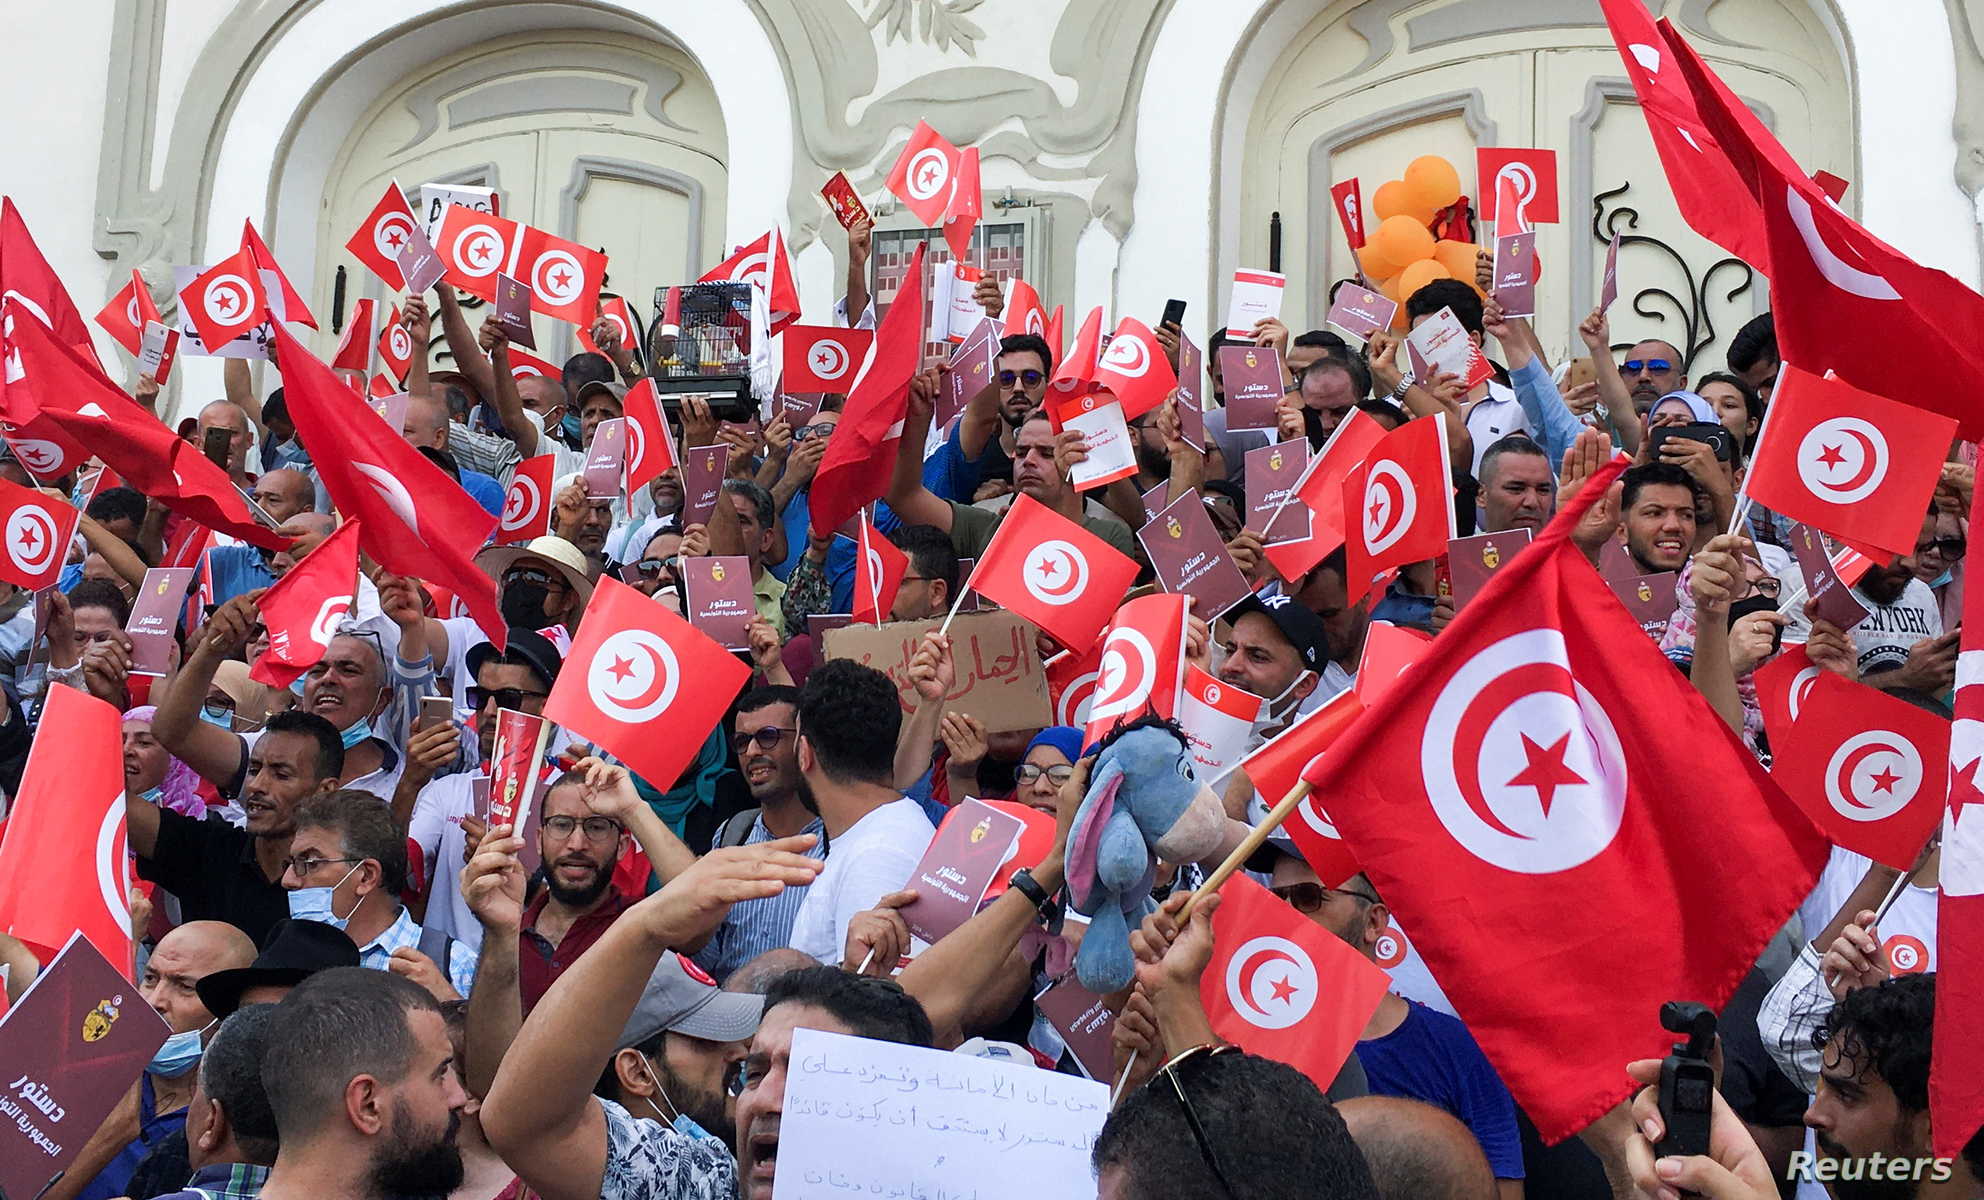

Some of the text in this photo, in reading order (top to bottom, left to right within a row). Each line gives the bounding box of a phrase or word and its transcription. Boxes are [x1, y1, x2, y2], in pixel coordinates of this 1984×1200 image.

[1244, 383, 1269, 393] دستور
[1264, 488, 1291, 502] دستور
[1181, 551, 1206, 576] دستور
[709, 600, 736, 610] دستور
[138, 616, 163, 626] دستور
[1882, 606, 1930, 636] YORK
[944, 625, 1031, 700] الحمار
[935, 865, 967, 886] دستور
[10, 1074, 66, 1123] دستور
[17, 1114, 63, 1158] الجمهورية
